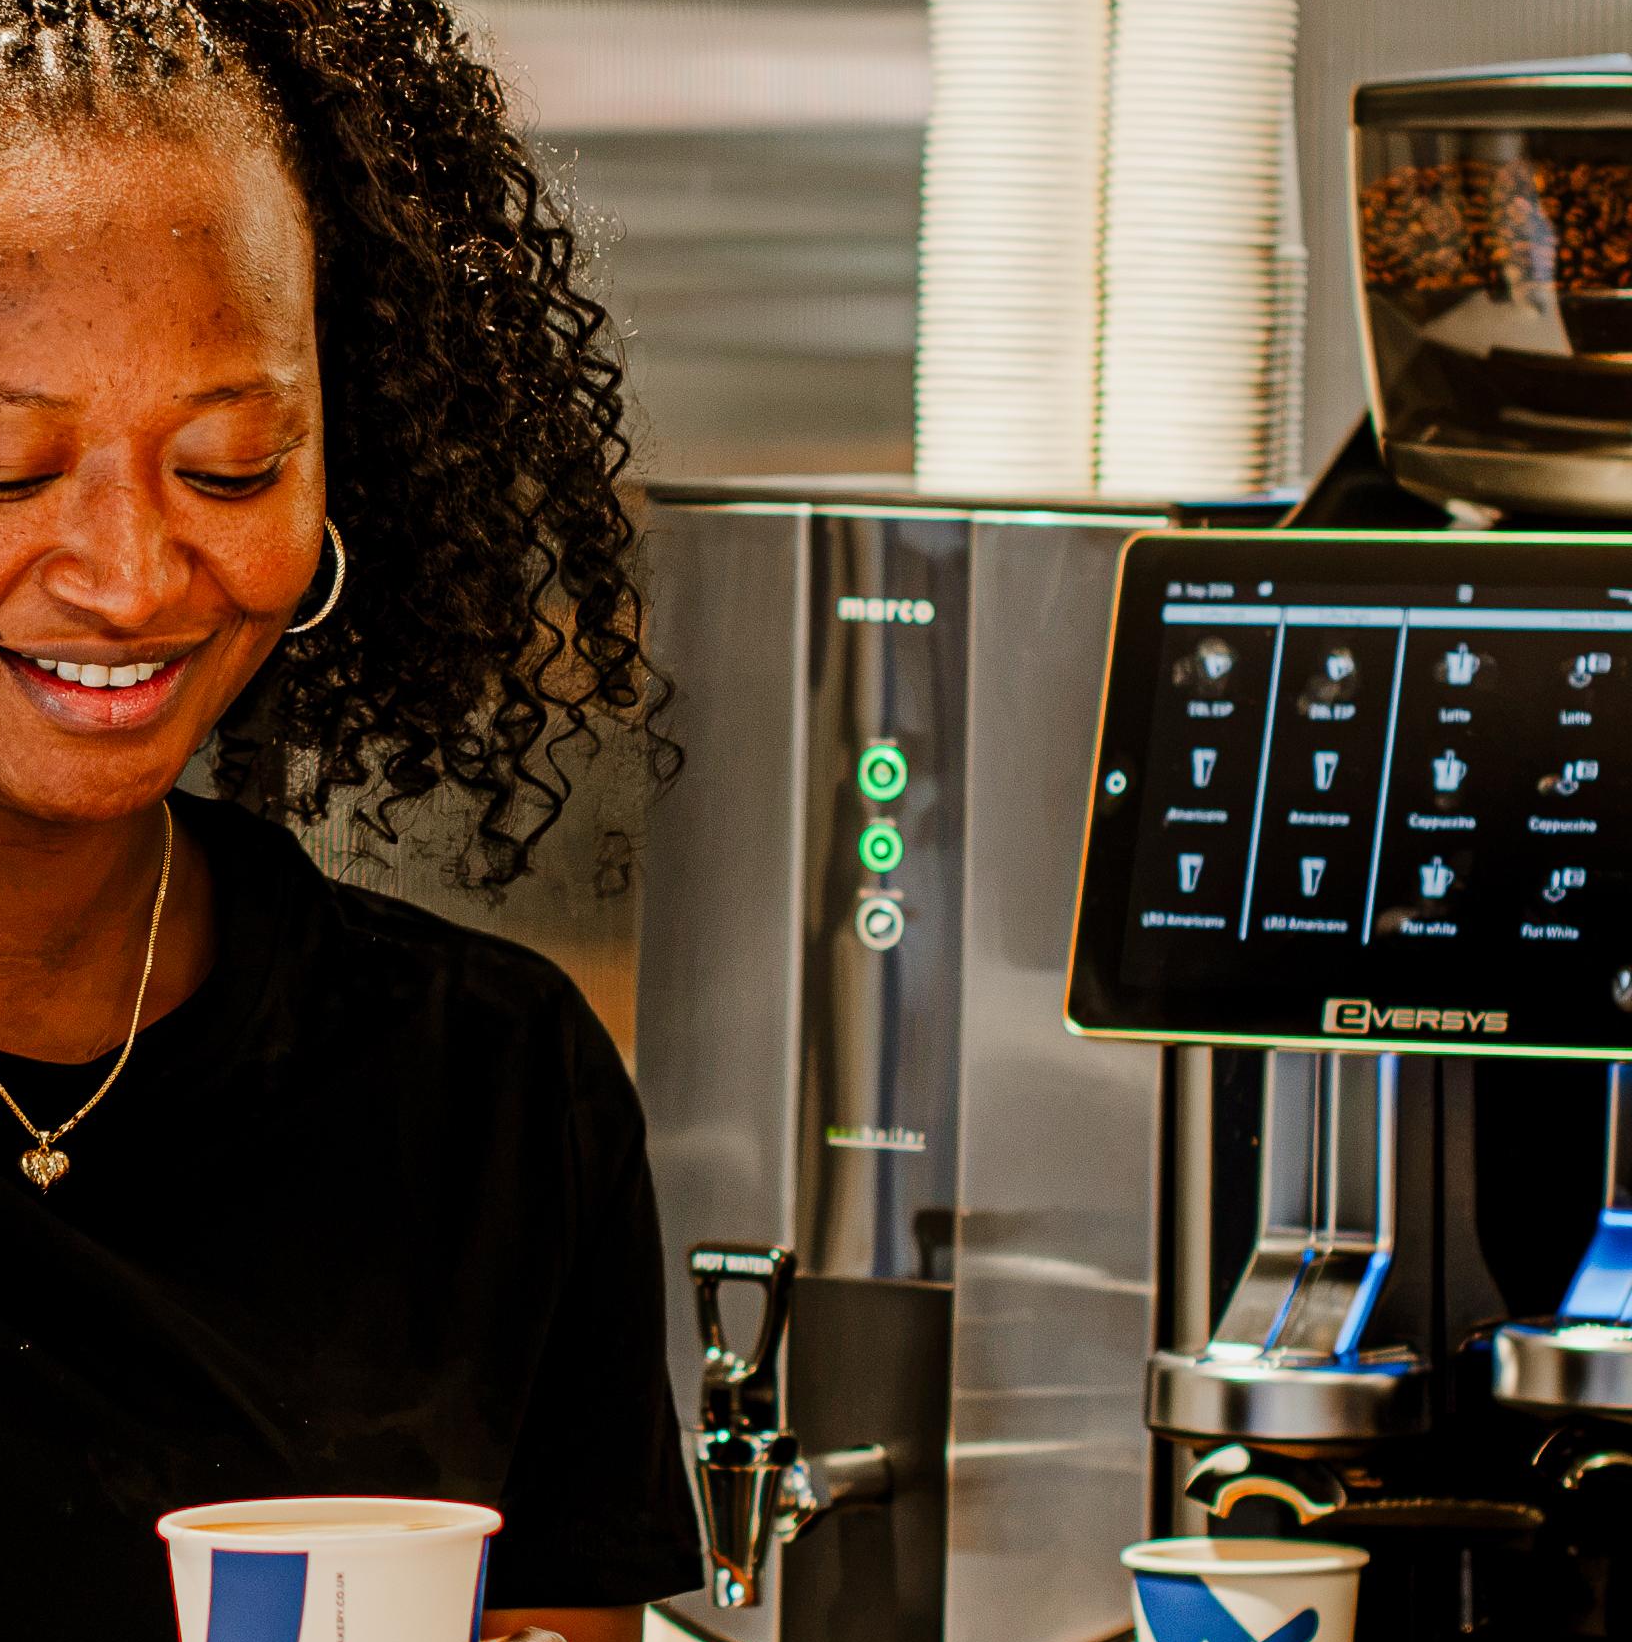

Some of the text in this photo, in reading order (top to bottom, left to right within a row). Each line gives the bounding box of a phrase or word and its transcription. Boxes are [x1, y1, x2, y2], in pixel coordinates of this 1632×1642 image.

[838, 597, 935, 624] marco
[1167, 807, 1228, 823] Americano
[1288, 810, 1350, 826] Americano
[1409, 813, 1476, 830] Cappuccino
[1529, 816, 1597, 834] Cappuccino
[692, 1252, 774, 1275] HOT WATER
